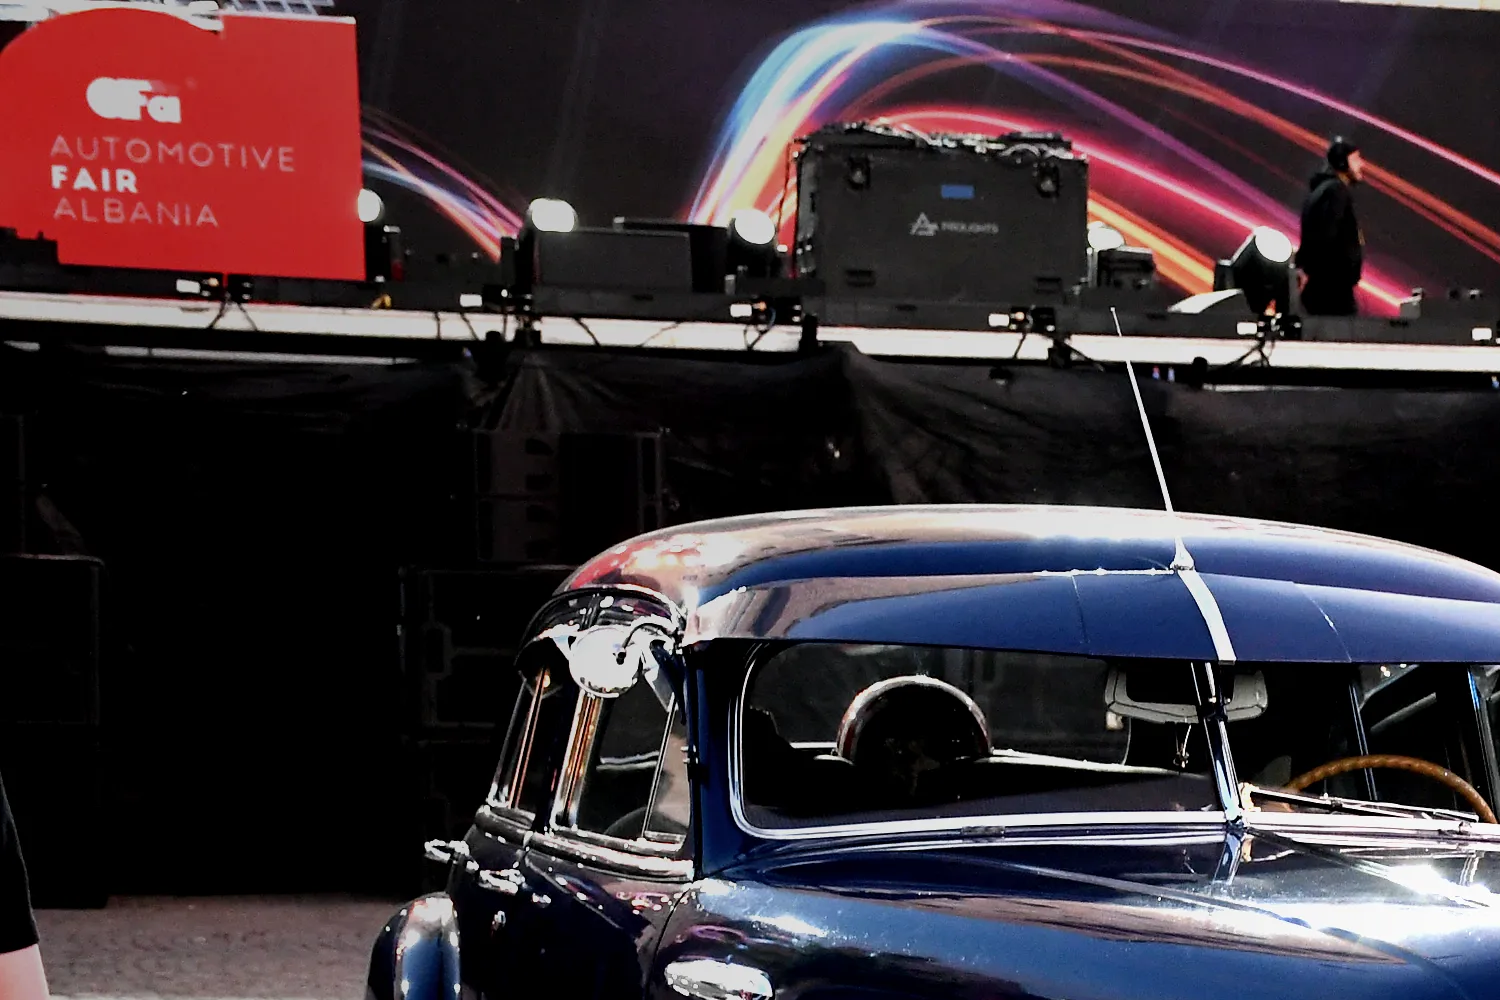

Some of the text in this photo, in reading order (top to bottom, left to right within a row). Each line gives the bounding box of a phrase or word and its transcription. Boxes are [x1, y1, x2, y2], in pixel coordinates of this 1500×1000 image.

[50, 134, 296, 172] AUTOMOTIVE
[51, 165, 138, 193] FAIR
[53, 197, 219, 227] ALBANIA
